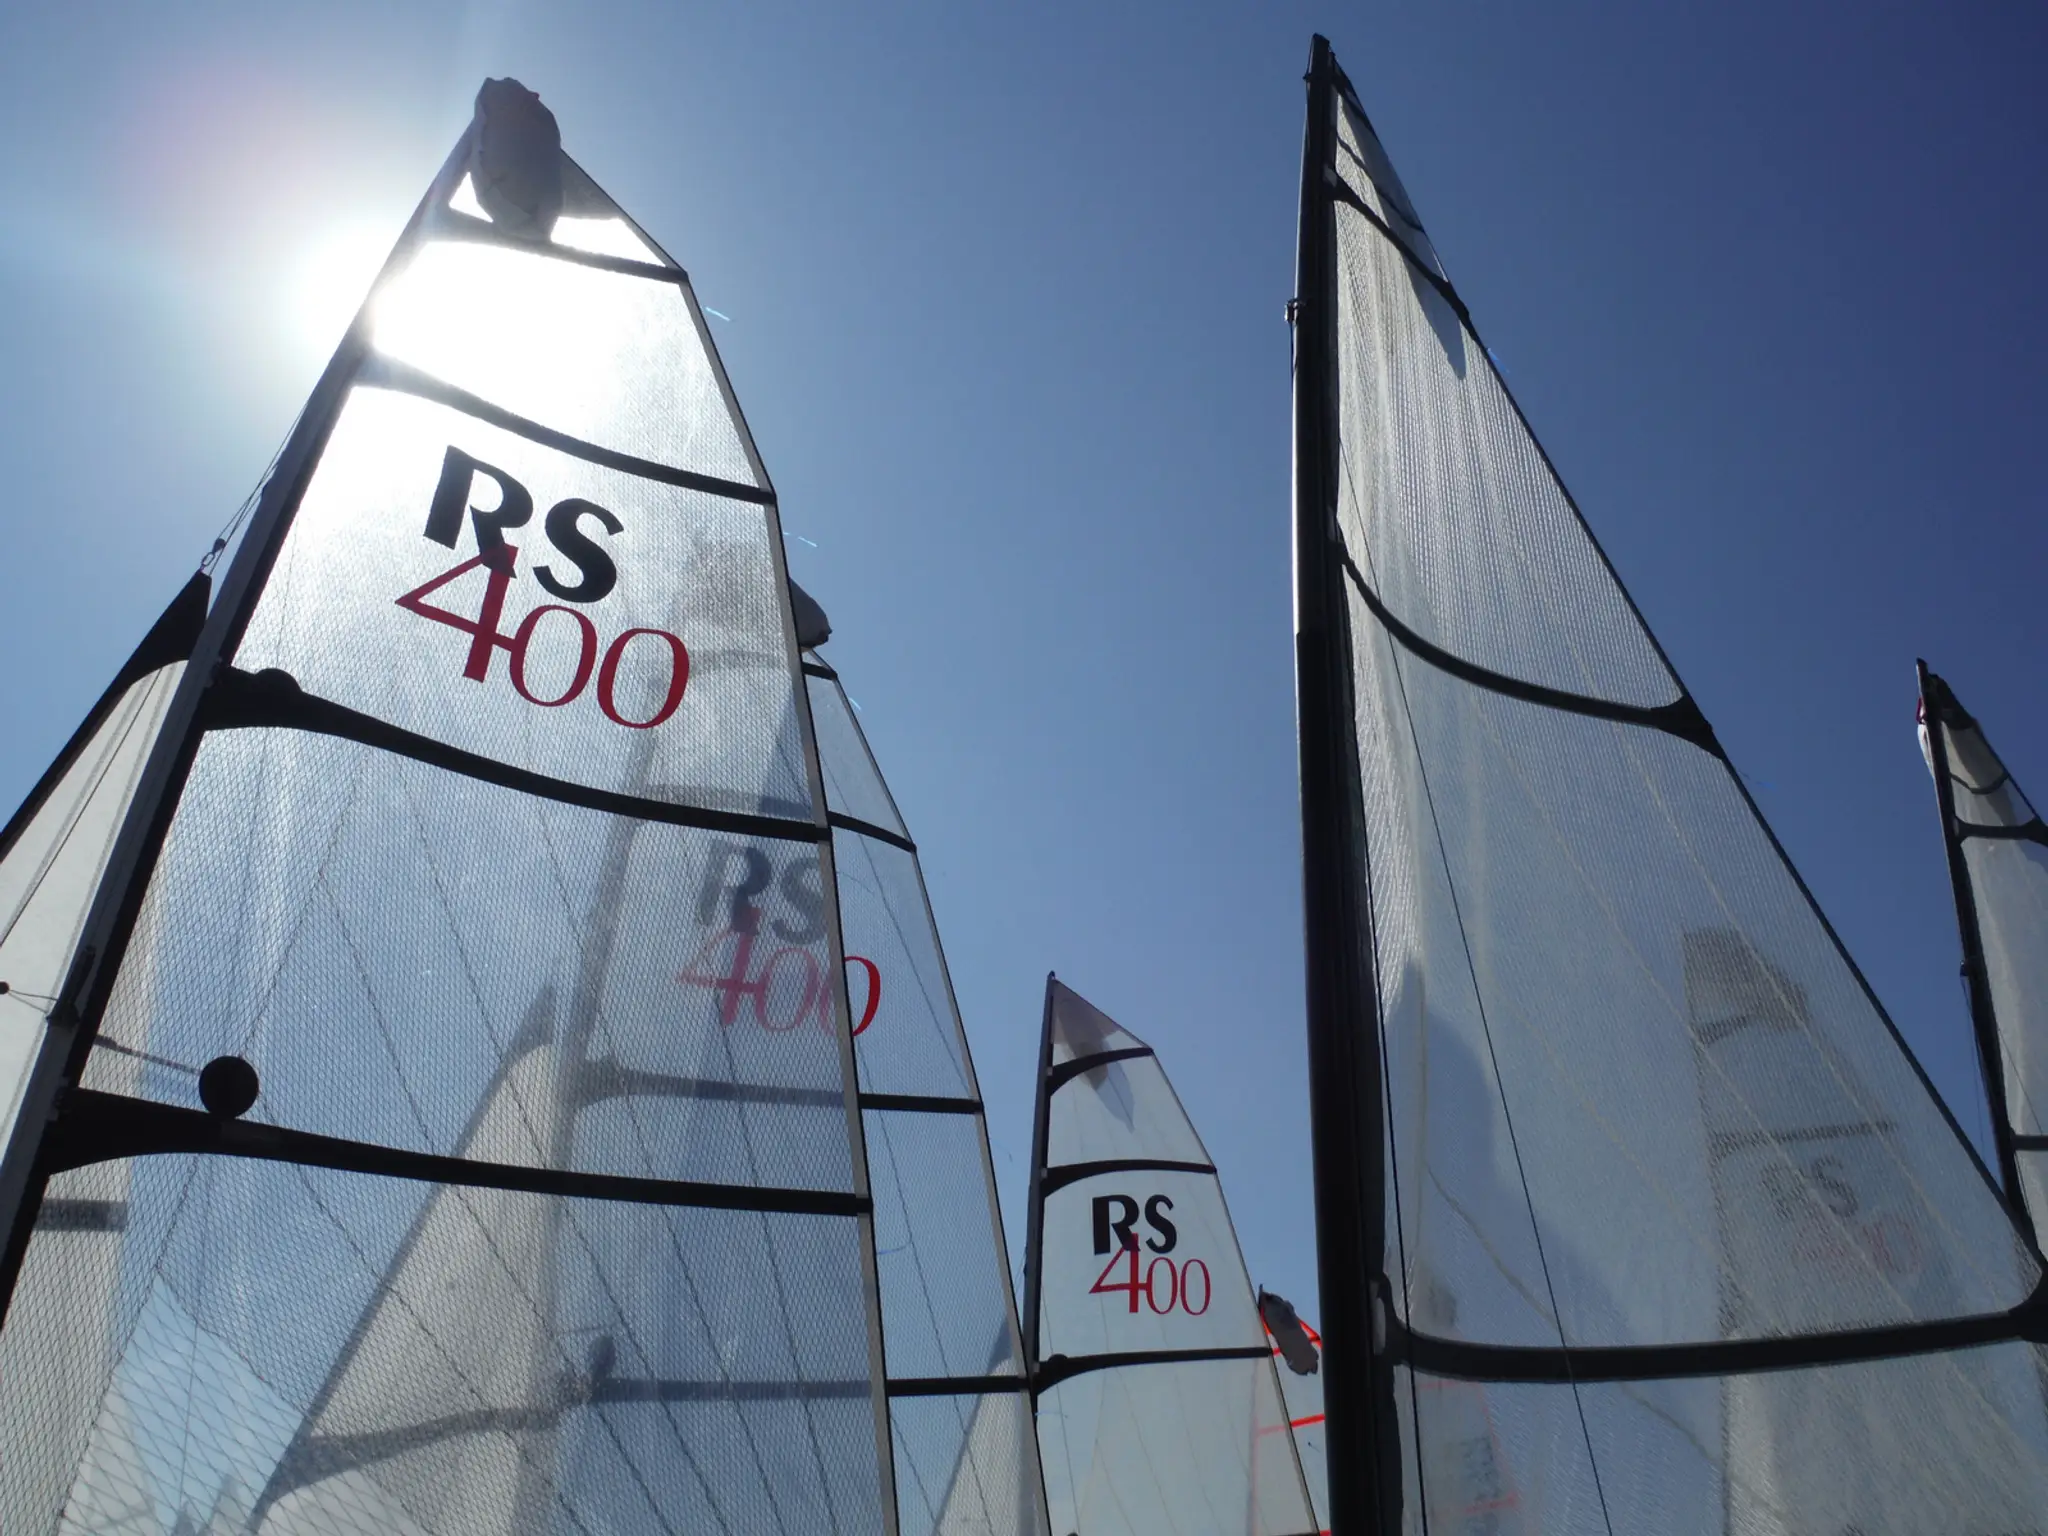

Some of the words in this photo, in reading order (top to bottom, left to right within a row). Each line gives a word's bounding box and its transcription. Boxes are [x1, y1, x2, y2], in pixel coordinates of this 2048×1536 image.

[423, 445, 625, 604] RS
[394, 542, 690, 729] 400
[697, 839, 831, 945] RS
[676, 903, 881, 1037] 400
[1088, 1232, 1211, 1316] 400
[1092, 1194, 1178, 1256] RS
